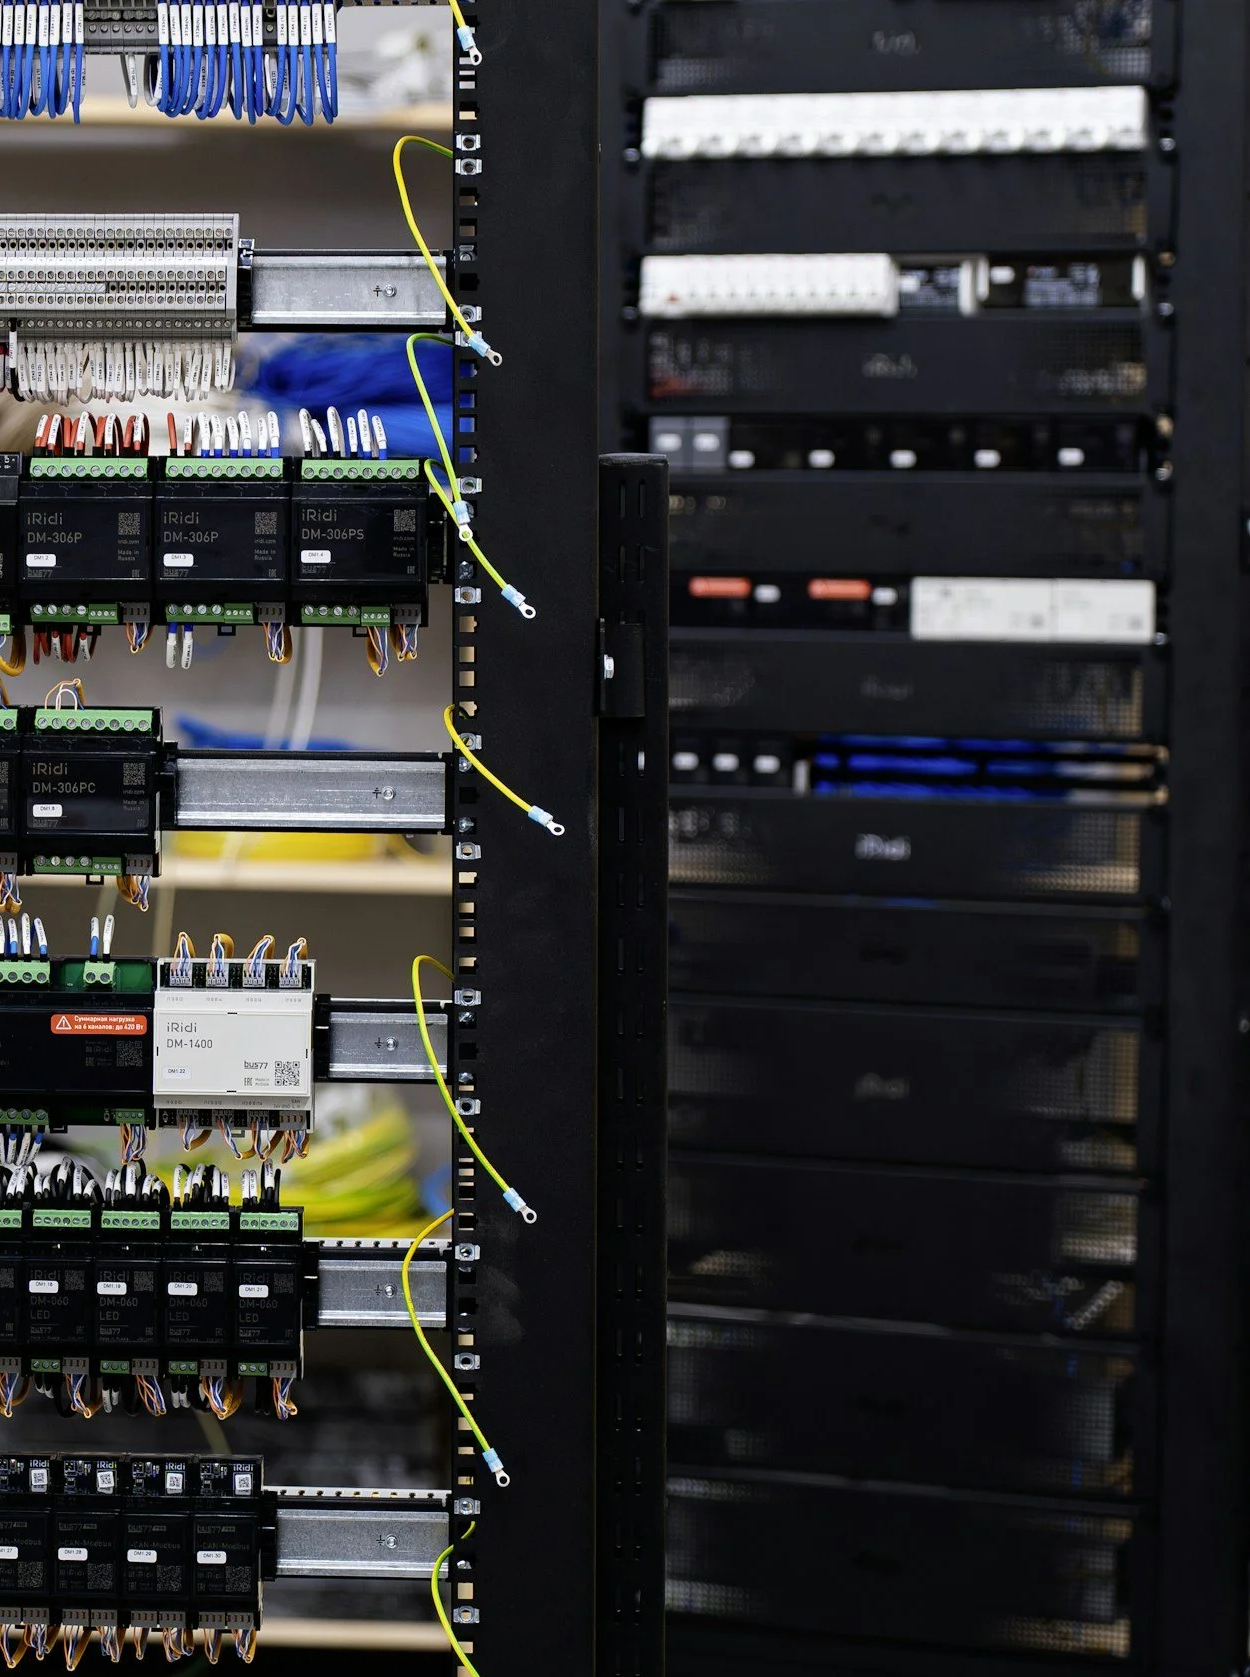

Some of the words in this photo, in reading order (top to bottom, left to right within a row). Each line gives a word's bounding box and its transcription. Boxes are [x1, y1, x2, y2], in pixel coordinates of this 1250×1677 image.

[28, 513, 63, 525] iRidi
[163, 512, 199, 524] iRidi
[302, 509, 337, 522] iRidi
[28, 532, 82, 543] DM-306P
[163, 531, 219, 543] DM-306P
[302, 528, 365, 540] DM-306PS
[32, 762, 68, 775] iRidi
[32, 782, 96, 794] DM-306PC
[167, 1022, 197, 1033] iRidi
[167, 1039, 213, 1049] DM-1400
[244, 1061, 269, 1070] bus77
[100, 1271, 130, 1282] iRidi
[30, 1296, 69, 1306] DM-060
[100, 1298, 138, 1307] DM-060
[169, 1298, 208, 1308] DM-060
[239, 1300, 278, 1309] DM-060
[31, 1310, 51, 1319] LED
[100, 1312, 120, 1321] LED
[169, 1312, 190, 1321] LED
[239, 1314, 259, 1323] LED
[165, 1463, 186, 1471] iRidi
[233, 1464, 254, 1472] iRidi
